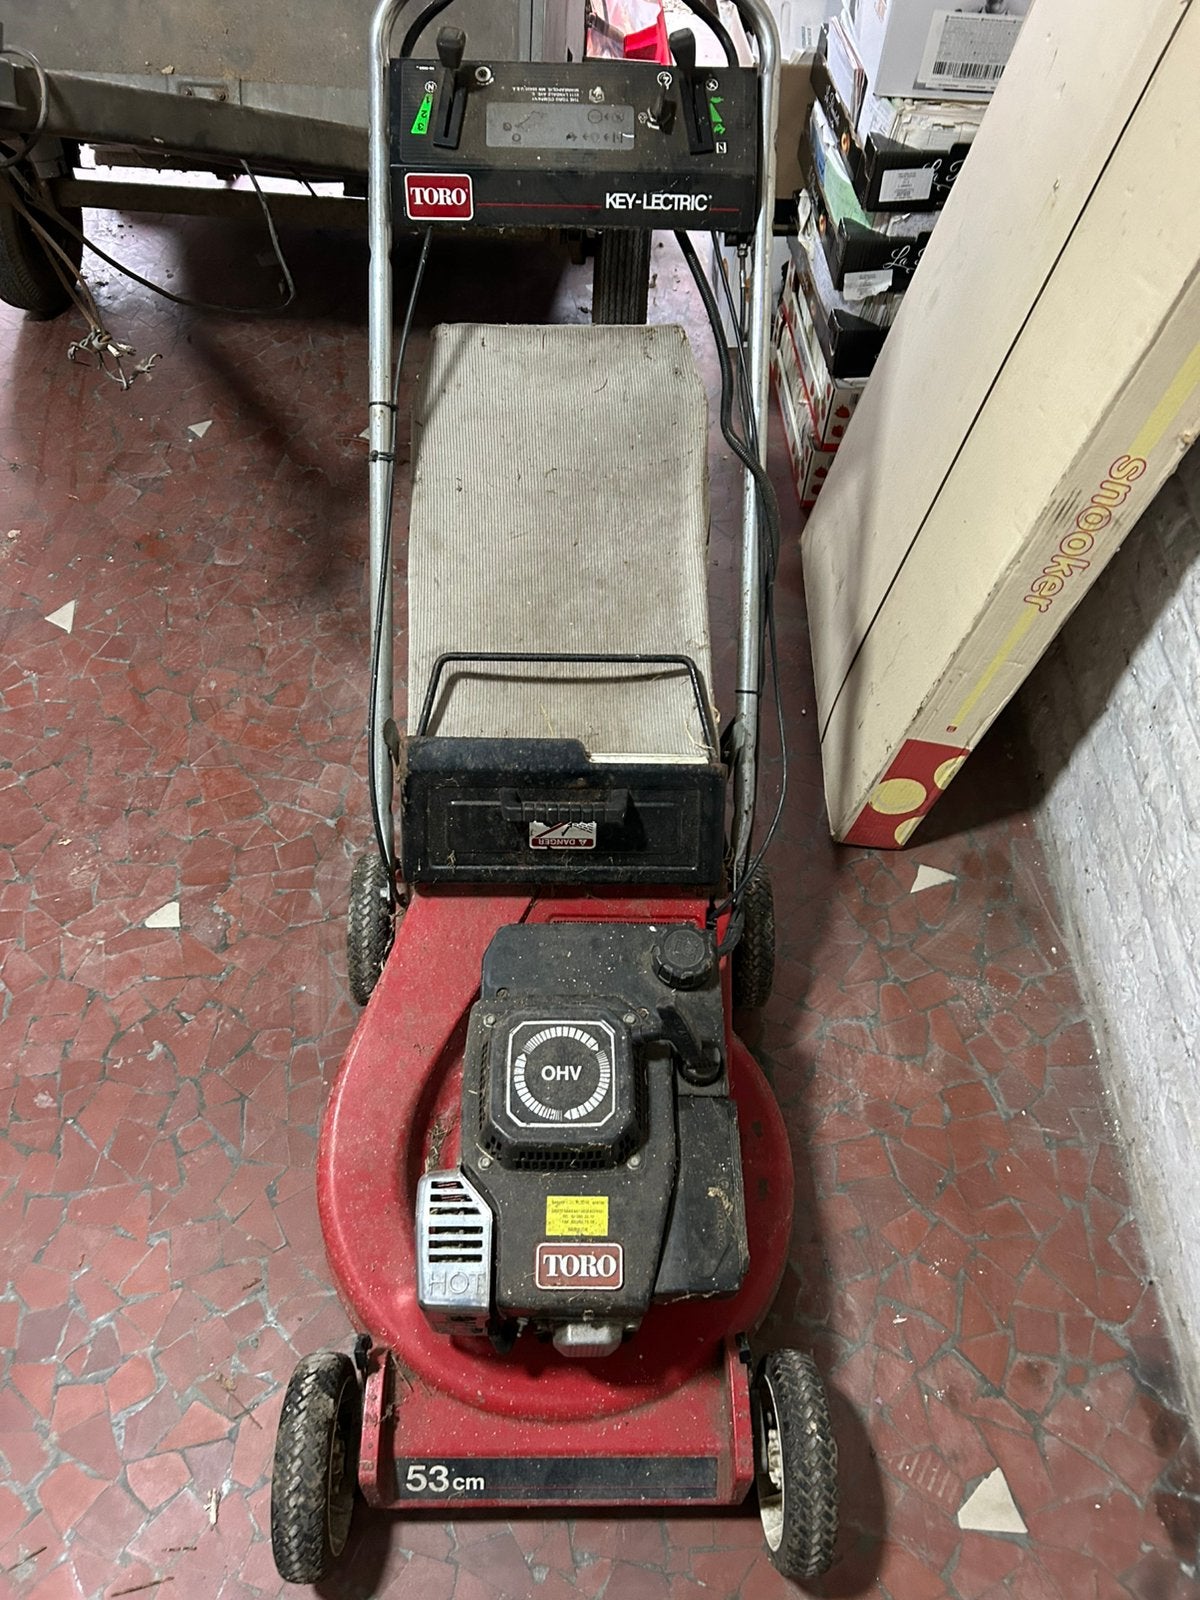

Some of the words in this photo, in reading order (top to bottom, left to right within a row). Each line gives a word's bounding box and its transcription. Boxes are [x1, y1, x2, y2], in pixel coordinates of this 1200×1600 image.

[410, 187, 468, 206] TORO
[605, 193, 708, 211] KEY-LECTRIC
[1024, 454, 1147, 613] snooker
[538, 838, 576, 846] DANGER
[541, 1065, 582, 1081] OHV
[542, 1254, 617, 1278] TORO
[429, 1271, 487, 1296] HOT
[405, 1464, 450, 1493] 53
[452, 1475, 485, 1491] cm
